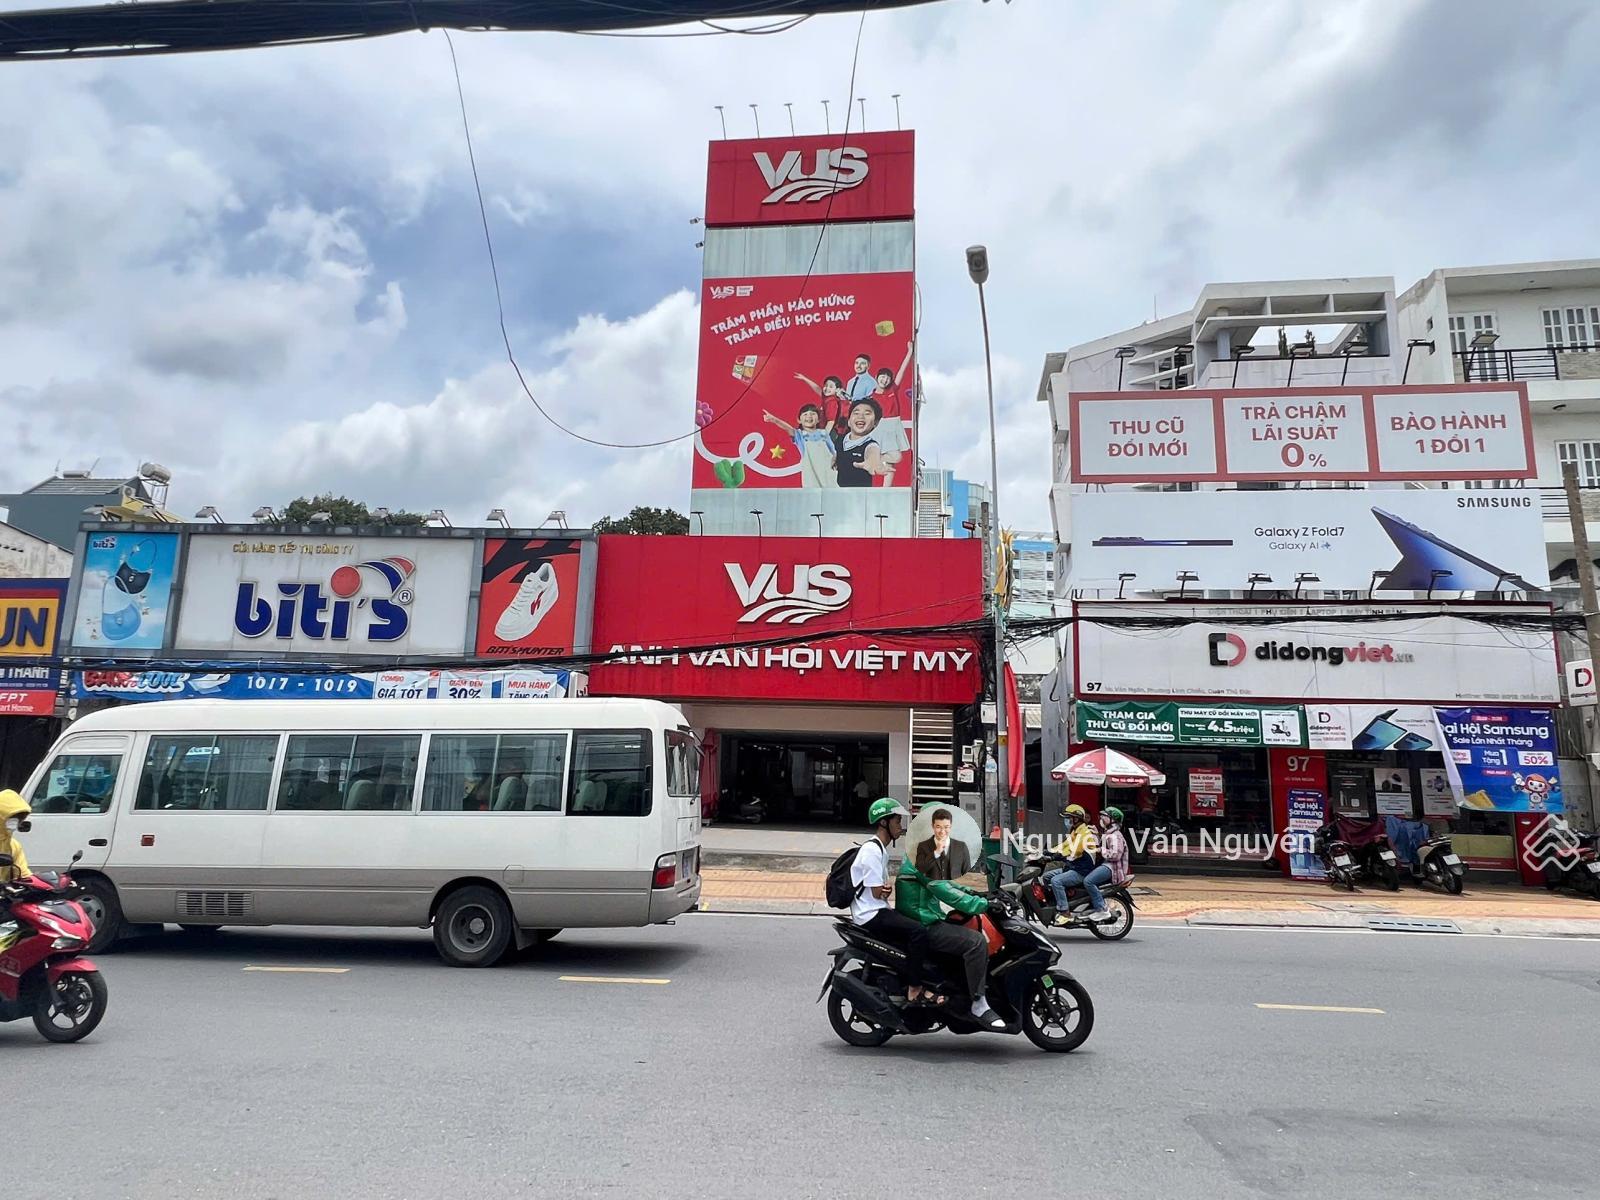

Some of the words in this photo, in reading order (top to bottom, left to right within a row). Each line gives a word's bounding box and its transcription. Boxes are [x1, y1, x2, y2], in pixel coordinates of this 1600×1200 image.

[753, 146, 869, 196] VUS
[710, 286, 735, 297] VUS
[710, 314, 746, 335] TRĂM
[725, 325, 761, 346] TRĂM
[795, 312, 821, 327] HỌC
[825, 311, 852, 322] HAY
[1241, 402, 1280, 420] TRẢ
[1285, 401, 1347, 421] CHẬM
[1109, 420, 1151, 435] THU
[1156, 416, 1184, 434] CŨ
[1441, 411, 1507, 430] HÀNH
[1252, 424, 1283, 441] LÃI
[1149, 438, 1188, 457] MỚI
[1415, 439, 1425, 453] 1
[1475, 438, 1485, 453] 1
[1457, 496, 1531, 508] SAMSUNG
[1254, 526, 1299, 539] Galaxy
[1302, 527, 1309, 537] Z
[1312, 526, 1345, 538] Fold7
[1269, 540, 1307, 551] Galaxy
[1309, 541, 1319, 550] AI
[724, 562, 853, 611] VUS
[765, 643, 822, 675] HỘI
[829, 644, 906, 676] VIỆT
[913, 647, 973, 672] MỸ
[247, 676, 289, 691] 10/7
[314, 678, 359, 693] 10/9
[377, 684, 398, 699] GIÁ
[400, 681, 423, 699] TỐT
[508, 681, 527, 689] MUA
[1086, 682, 1102, 692] 97
[11, 703, 34, 713] Home
[1102, 710, 1134, 720] THAM
[1136, 711, 1156, 720] GIA
[1086, 720, 1109, 729] THU
[1111, 721, 1126, 730] CŨ
[1151, 721, 1174, 732] MỚI
[1460, 723, 1480, 738] Hội
[1482, 724, 1549, 739] Samsung
[1452, 736, 1470, 744] Sale
[1486, 736, 1506, 745] Nhất
[1507, 737, 1534, 748] Tháng
[1287, 755, 1310, 772] 97
[1523, 755, 1549, 765] 50%
[1293, 801, 1306, 811] Đại
[1307, 802, 1319, 811] Hội
[1289, 809, 1324, 819] Samsung
